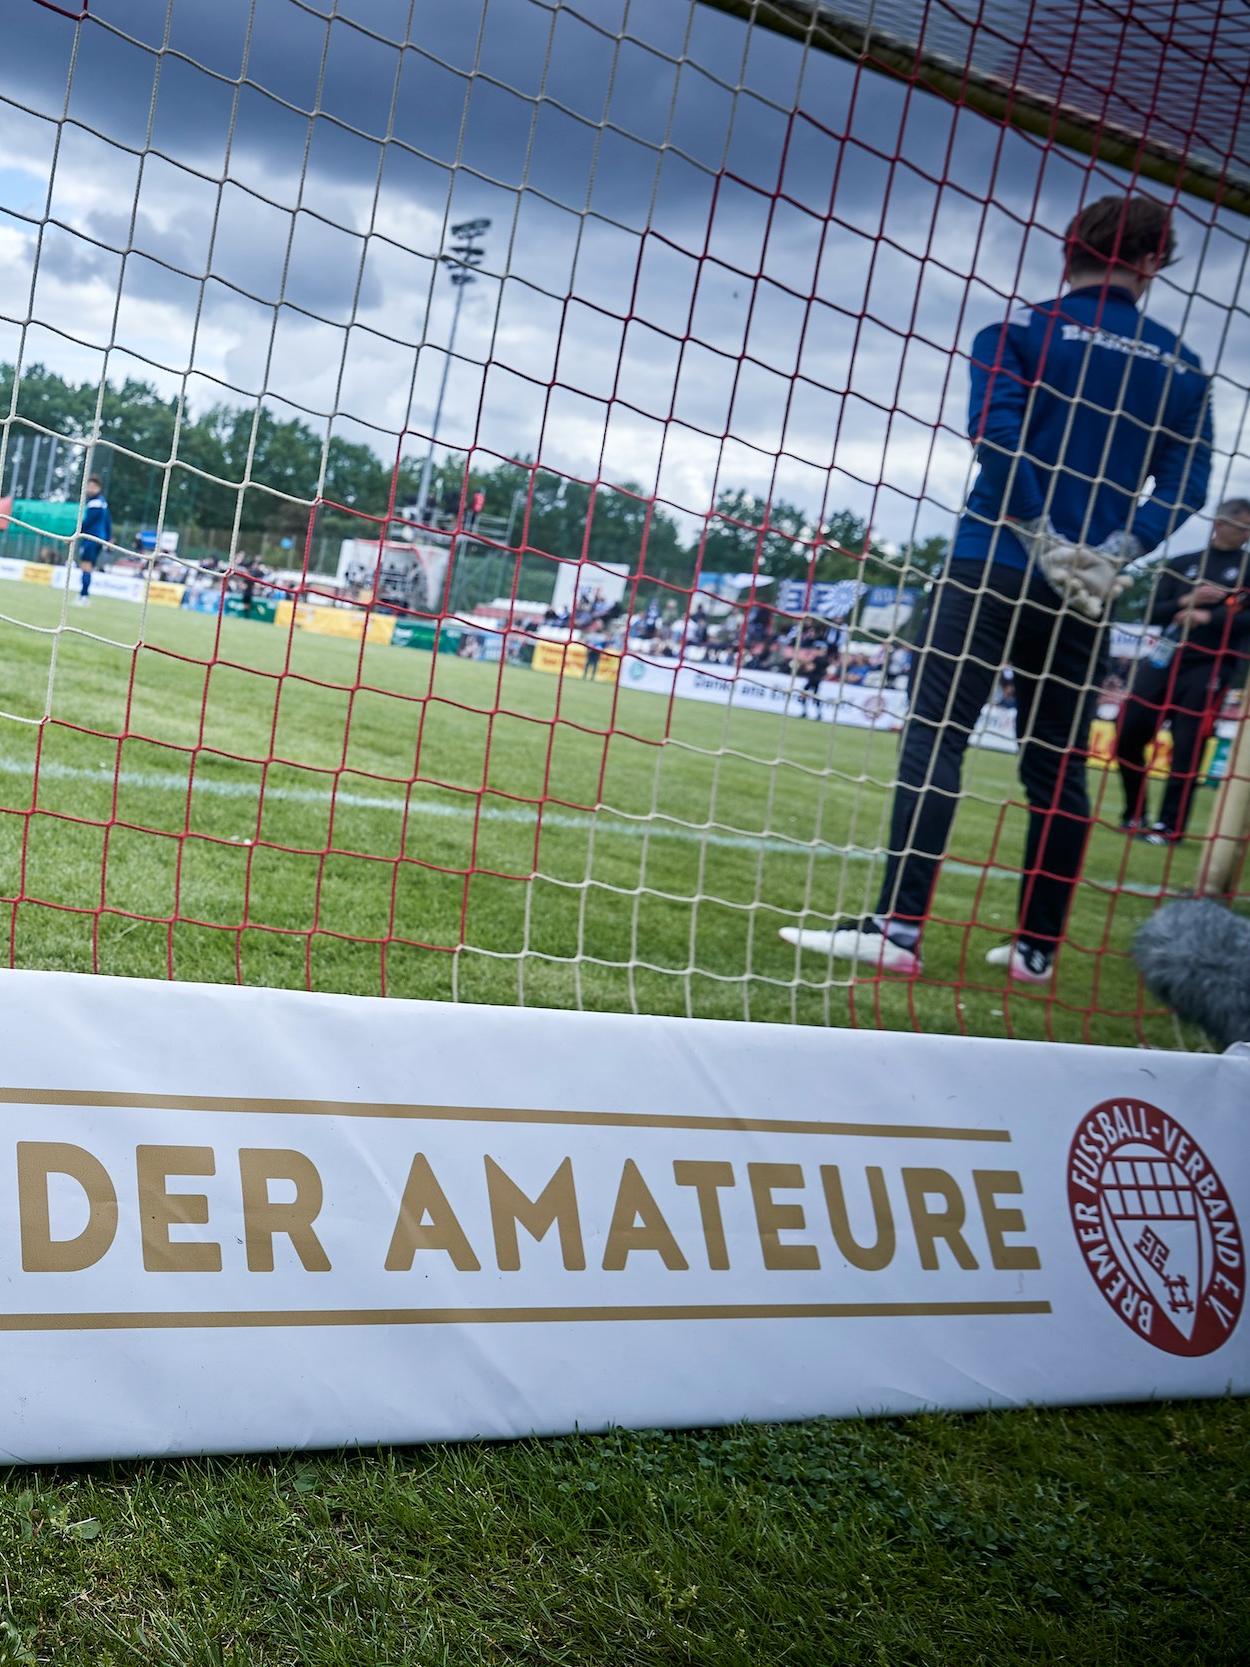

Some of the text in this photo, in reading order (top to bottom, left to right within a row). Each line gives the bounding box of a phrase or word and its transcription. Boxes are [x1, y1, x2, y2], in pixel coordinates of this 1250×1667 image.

[18, 1141, 331, 1273] DER
[385, 1152, 1040, 1271] AMATEURE
[1071, 1104, 1241, 1269] FUSSBALL-VERBAND
[1074, 1200, 1156, 1336] BREMER
